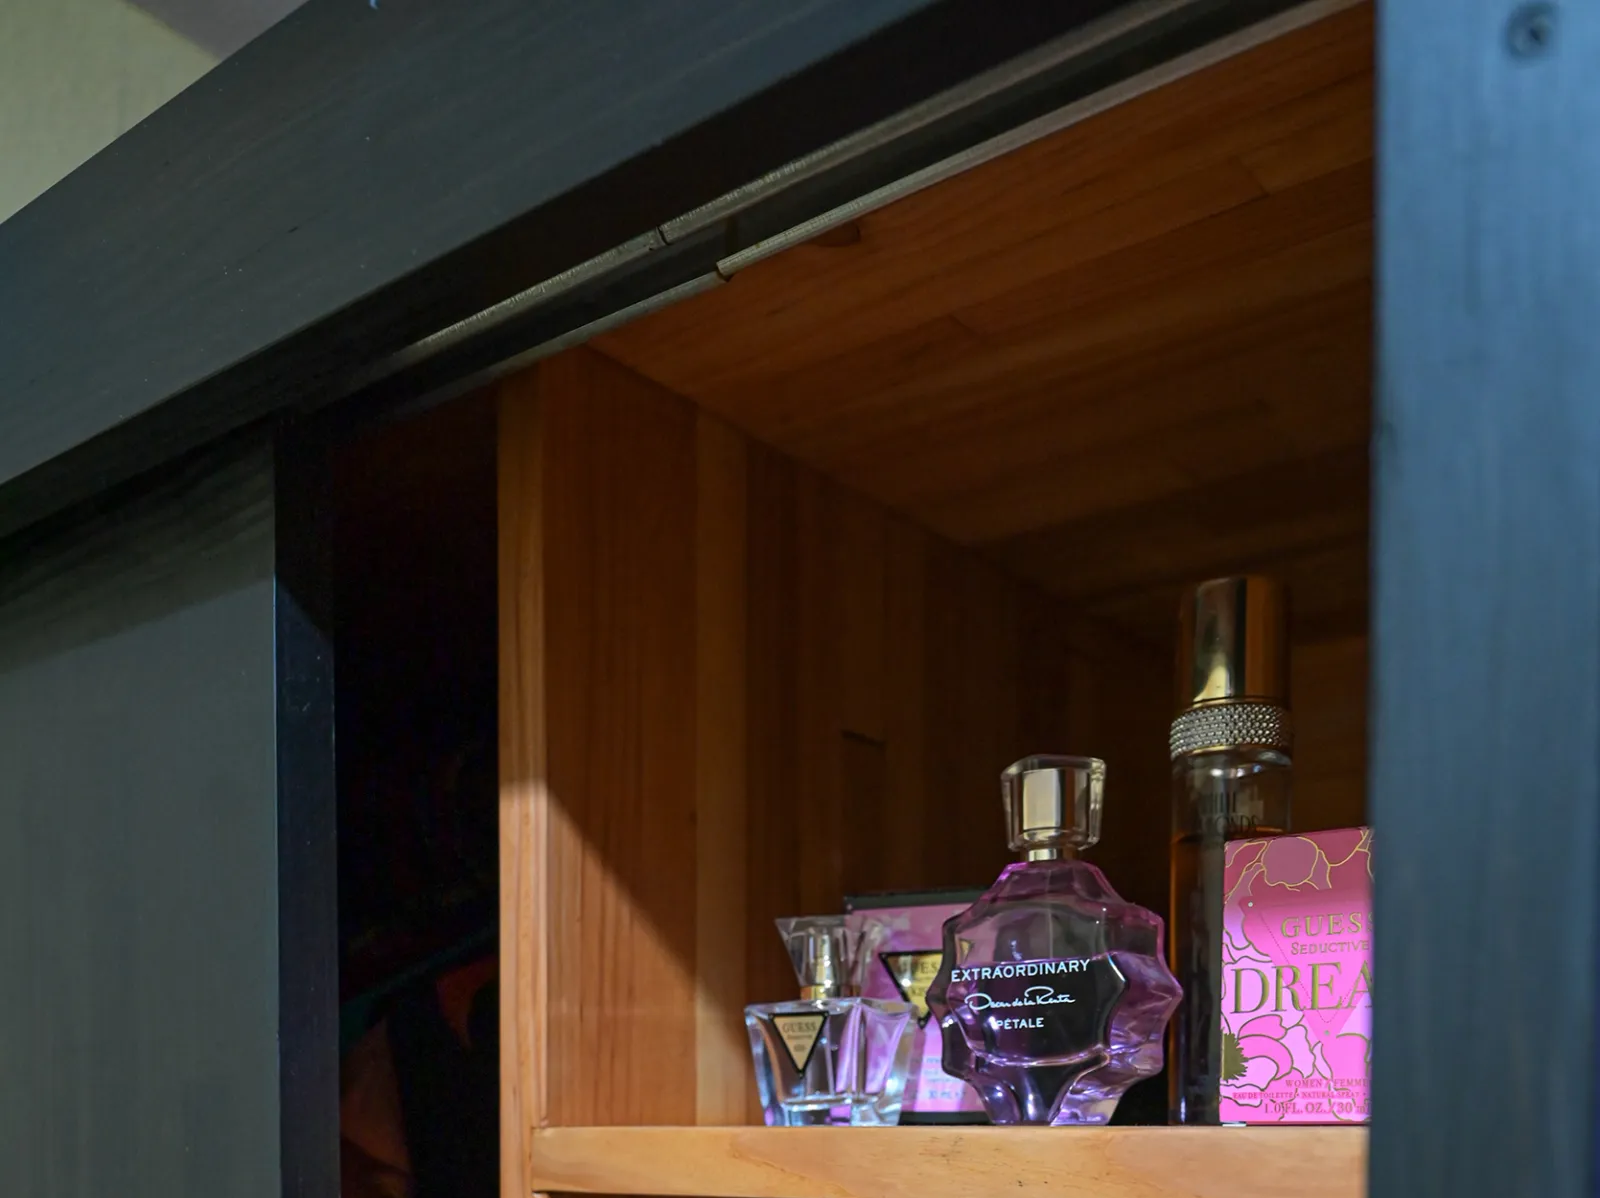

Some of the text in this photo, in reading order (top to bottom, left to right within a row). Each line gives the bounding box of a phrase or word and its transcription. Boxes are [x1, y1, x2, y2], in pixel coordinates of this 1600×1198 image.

[1291, 939, 1369, 956] SEDUCTIVE
[951, 959, 1090, 982] EXTRAORDINARY
[996, 1017, 1044, 1030] PÉTALE
[1285, 1079, 1322, 1088] WOMEN
[1232, 1092, 1247, 1100] EAU
[1302, 1091, 1334, 1099] NATURAL
